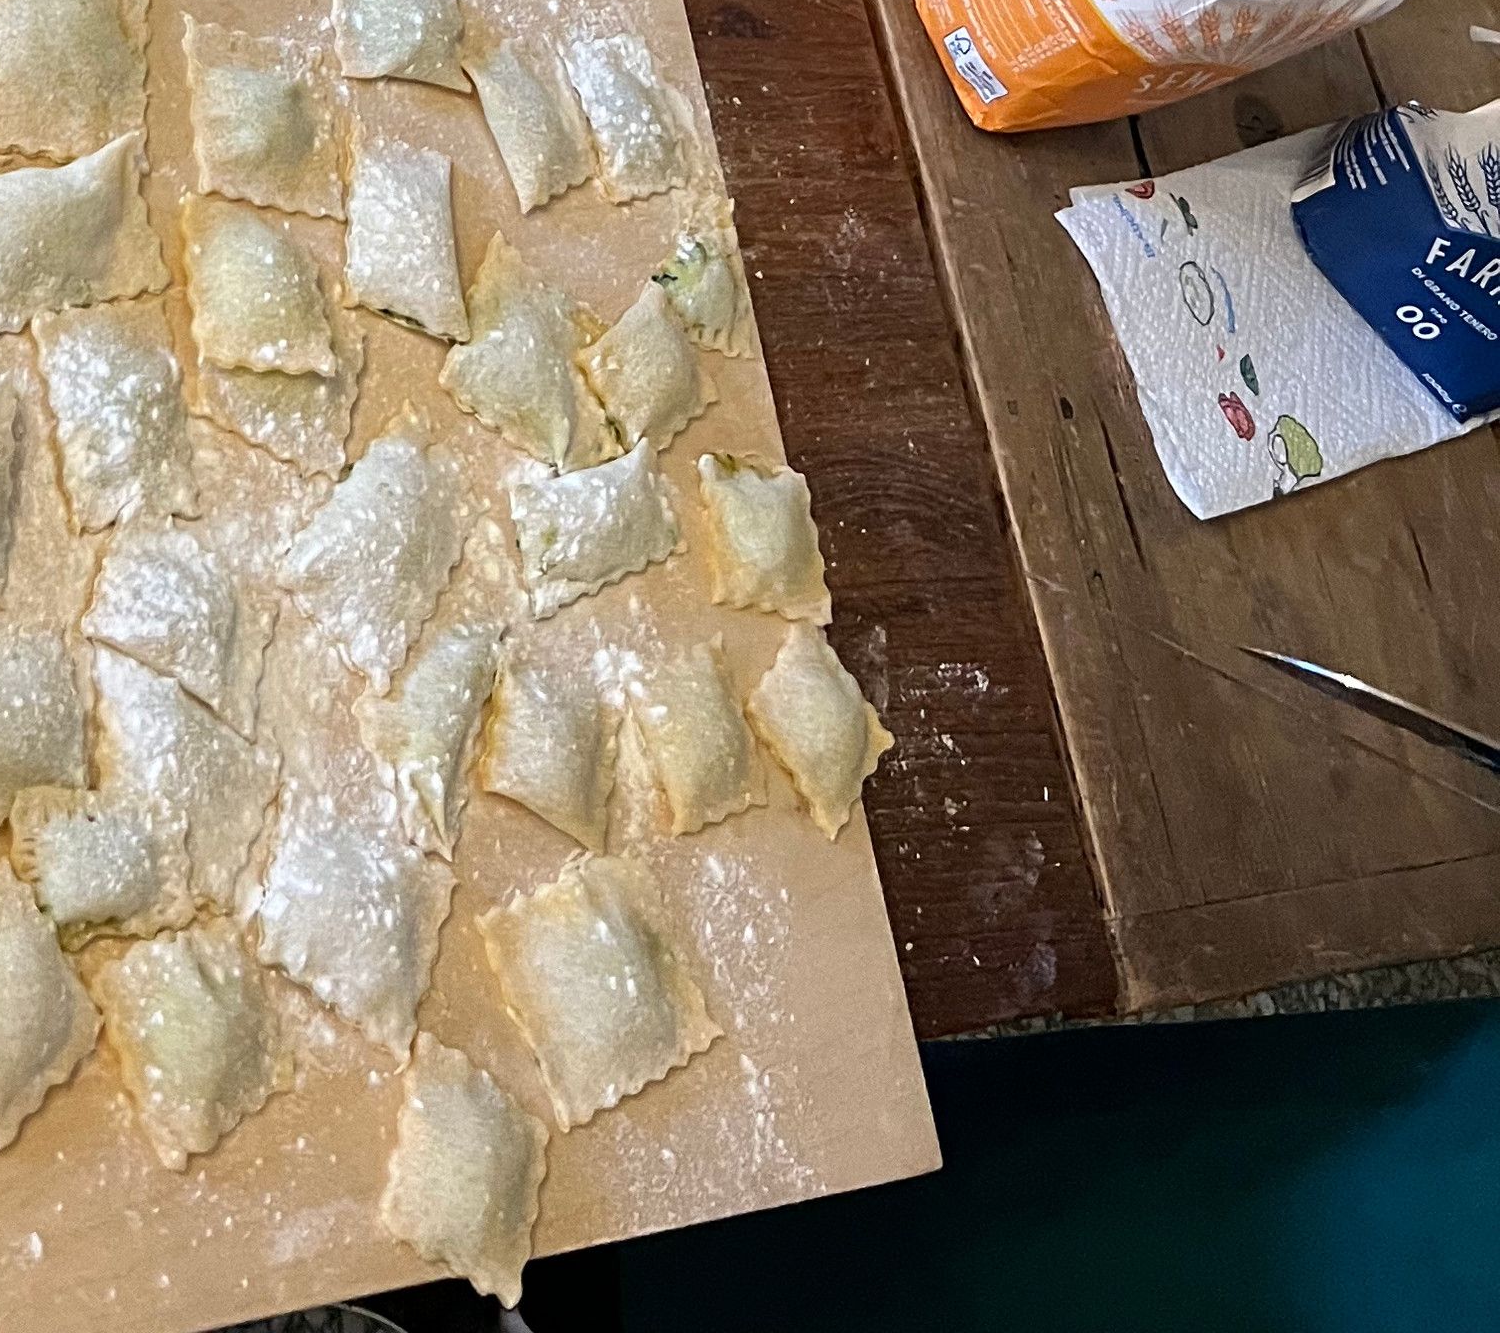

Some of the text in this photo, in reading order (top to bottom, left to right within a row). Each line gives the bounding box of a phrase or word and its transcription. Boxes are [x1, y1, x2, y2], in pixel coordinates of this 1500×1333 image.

[1411, 267, 1498, 341] DI GRANO TENERO
